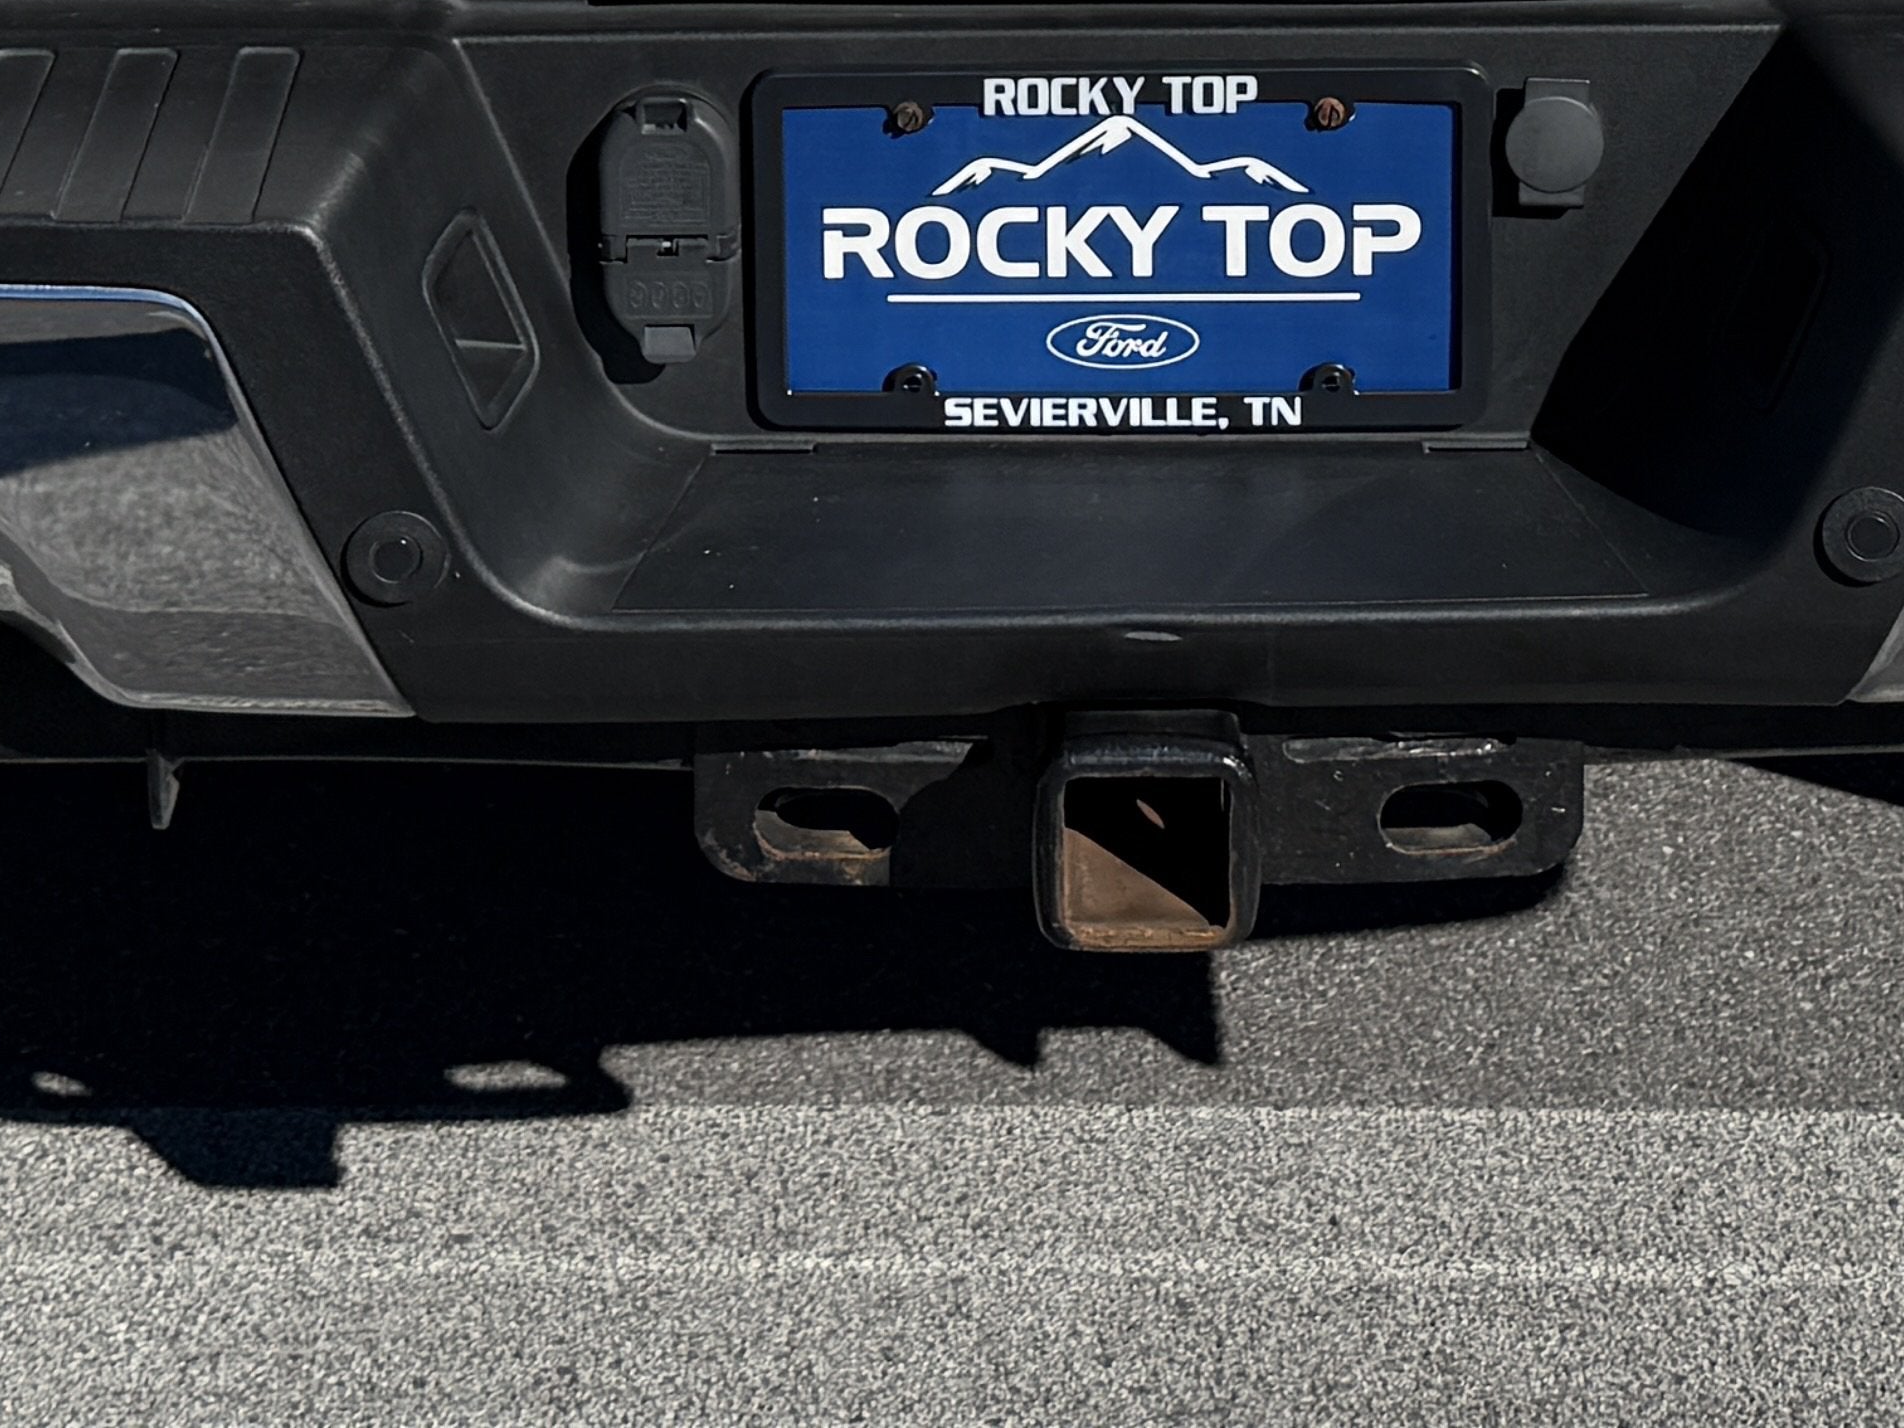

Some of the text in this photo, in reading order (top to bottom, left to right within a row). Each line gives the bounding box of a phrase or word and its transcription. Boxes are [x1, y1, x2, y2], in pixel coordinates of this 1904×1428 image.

[983, 75, 1258, 116] ROCKY TOP
[821, 203, 1423, 280] ROCKY TOP
[1075, 321, 1169, 359] Ford
[943, 396, 1302, 431] SEVIERVILLE, TN
